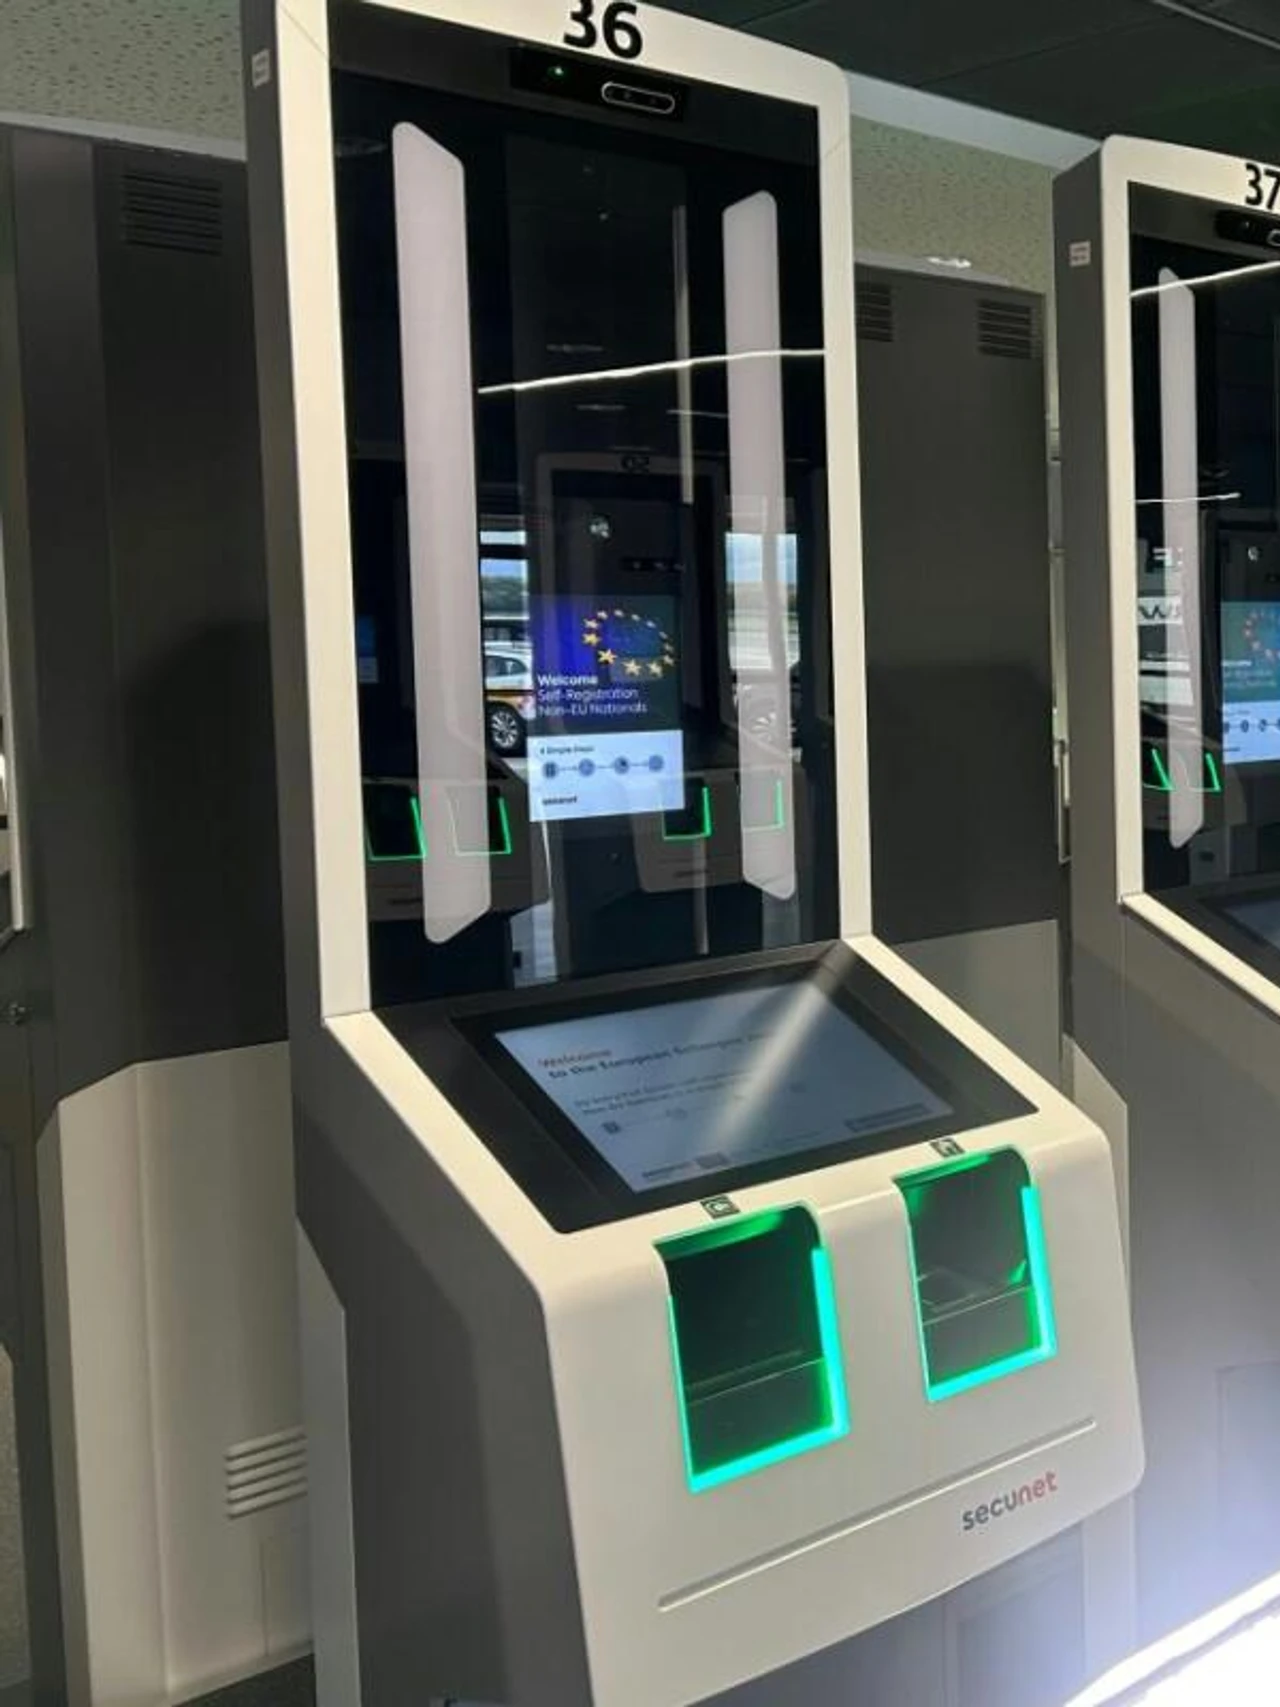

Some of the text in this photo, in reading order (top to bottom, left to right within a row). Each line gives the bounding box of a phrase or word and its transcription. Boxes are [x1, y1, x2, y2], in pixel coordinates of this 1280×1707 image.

[563, 0, 643, 59] 36
[537, 673, 598, 686] Welcome
[538, 688, 638, 702] Self-Registration
[962, 1471, 1058, 1531] secunet
